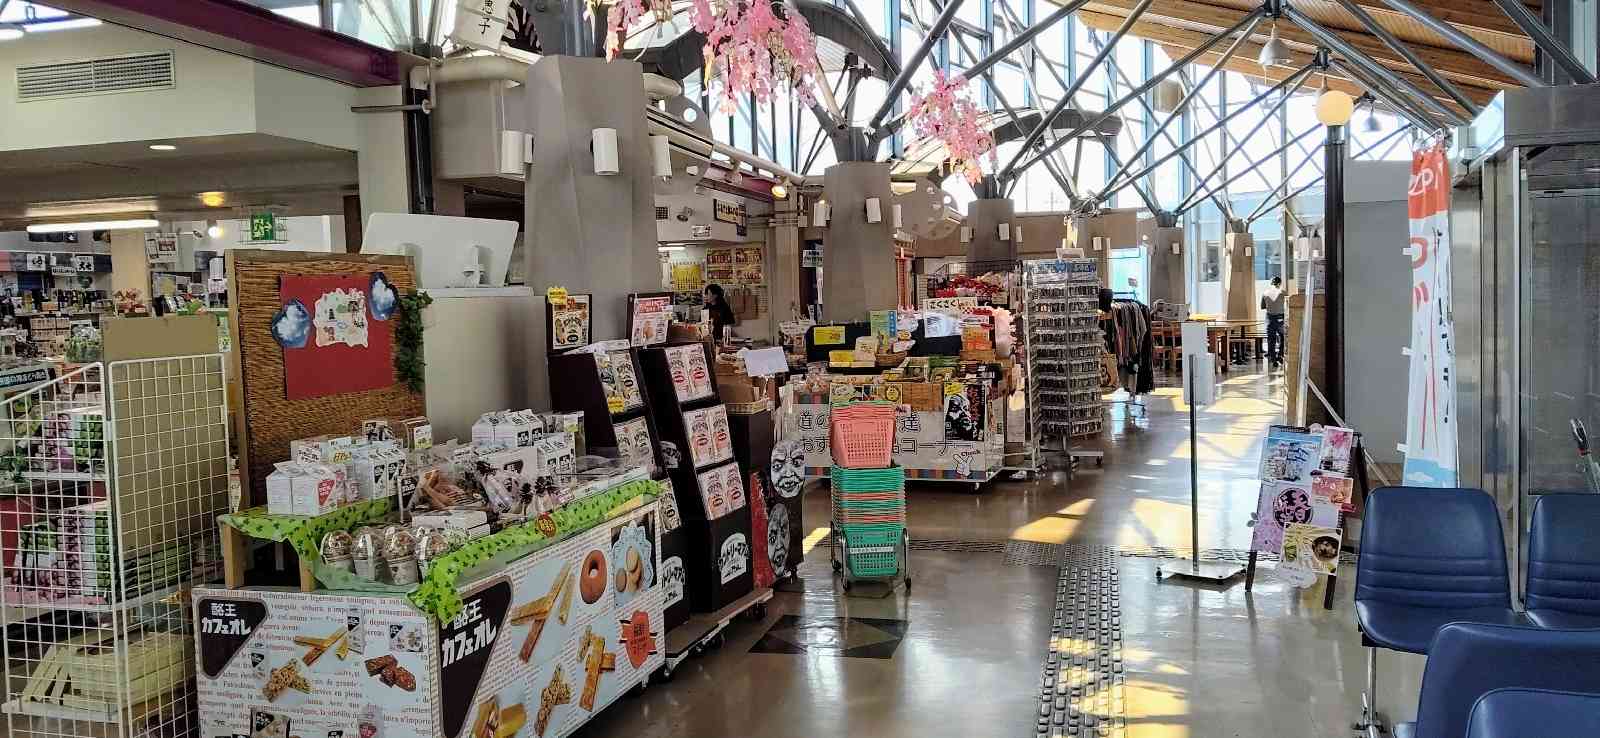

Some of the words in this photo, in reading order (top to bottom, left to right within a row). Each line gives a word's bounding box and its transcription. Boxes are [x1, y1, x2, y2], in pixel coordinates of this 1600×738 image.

[201, 616, 252, 636] カフェオレ
[441, 618, 497, 669] カフェオレ
